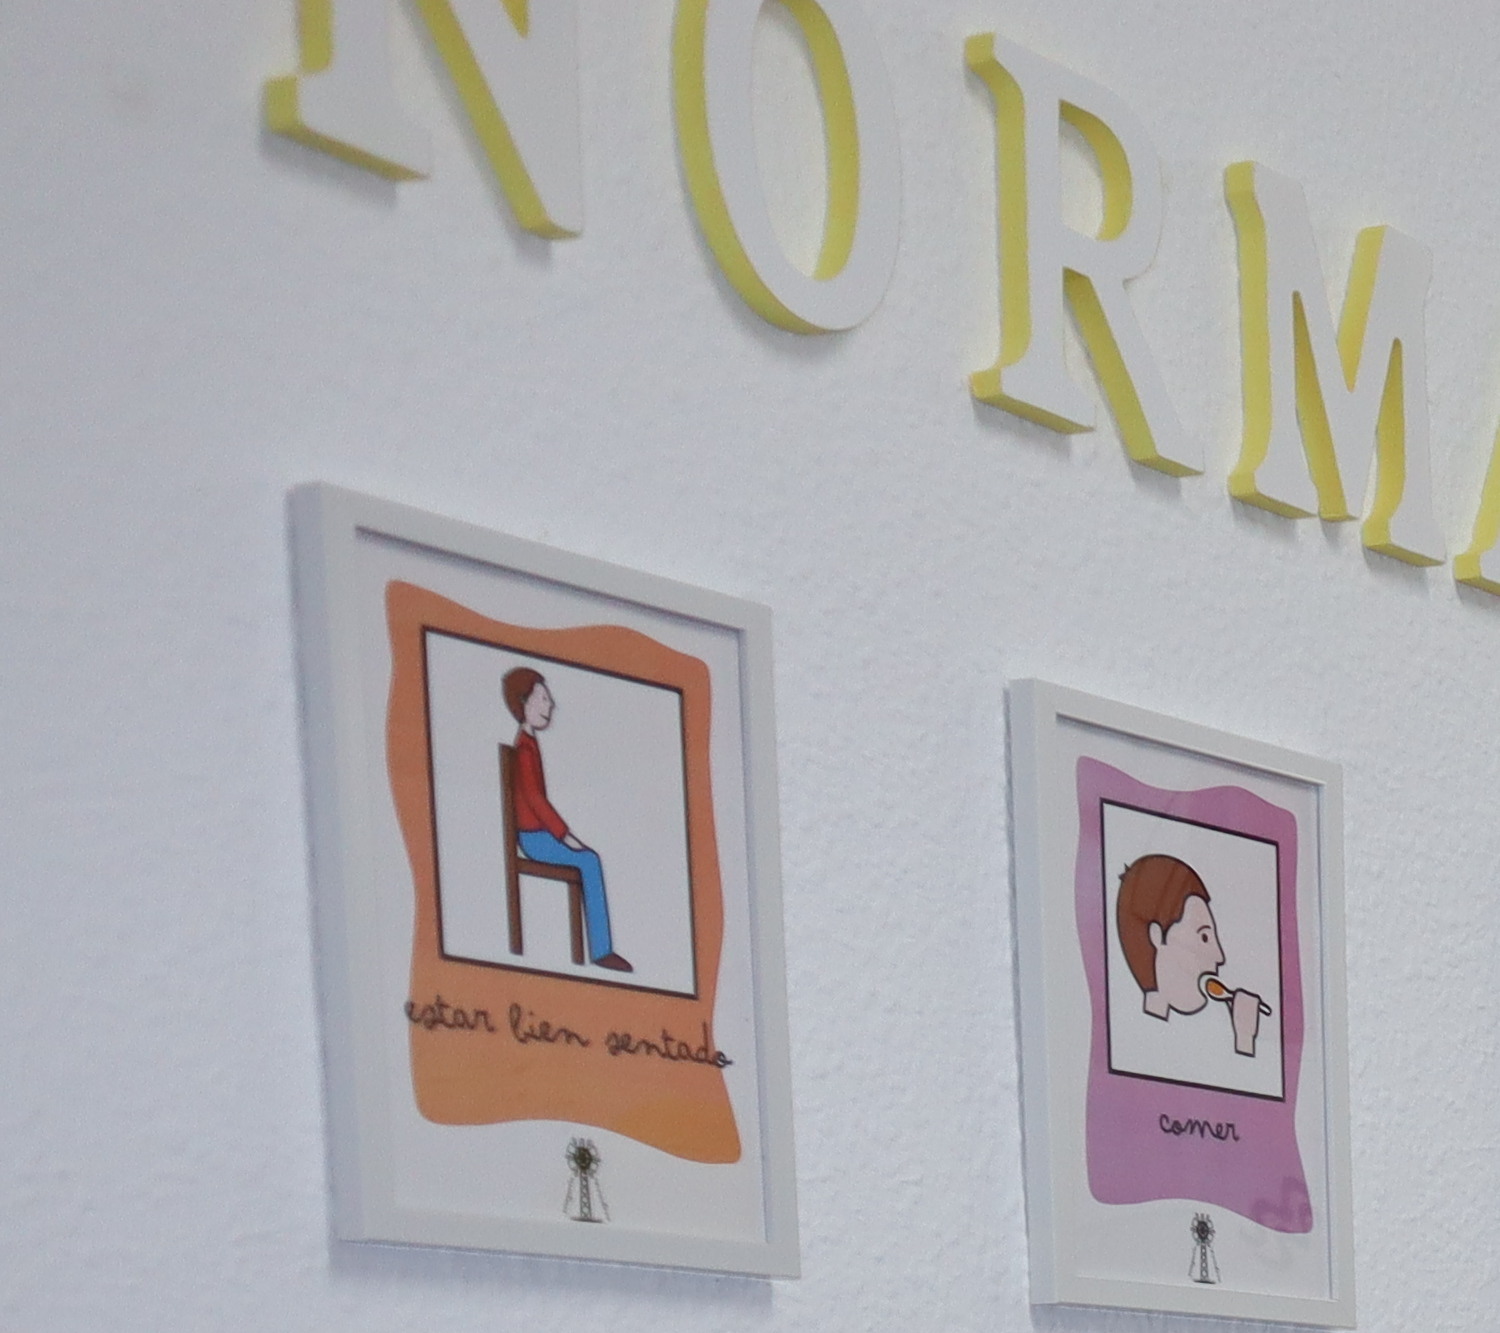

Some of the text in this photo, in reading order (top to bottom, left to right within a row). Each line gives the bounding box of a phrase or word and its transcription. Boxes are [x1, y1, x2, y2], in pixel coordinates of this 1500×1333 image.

[404, 995, 733, 1069] estar bien sentado
[1158, 1114, 1240, 1142] comer
